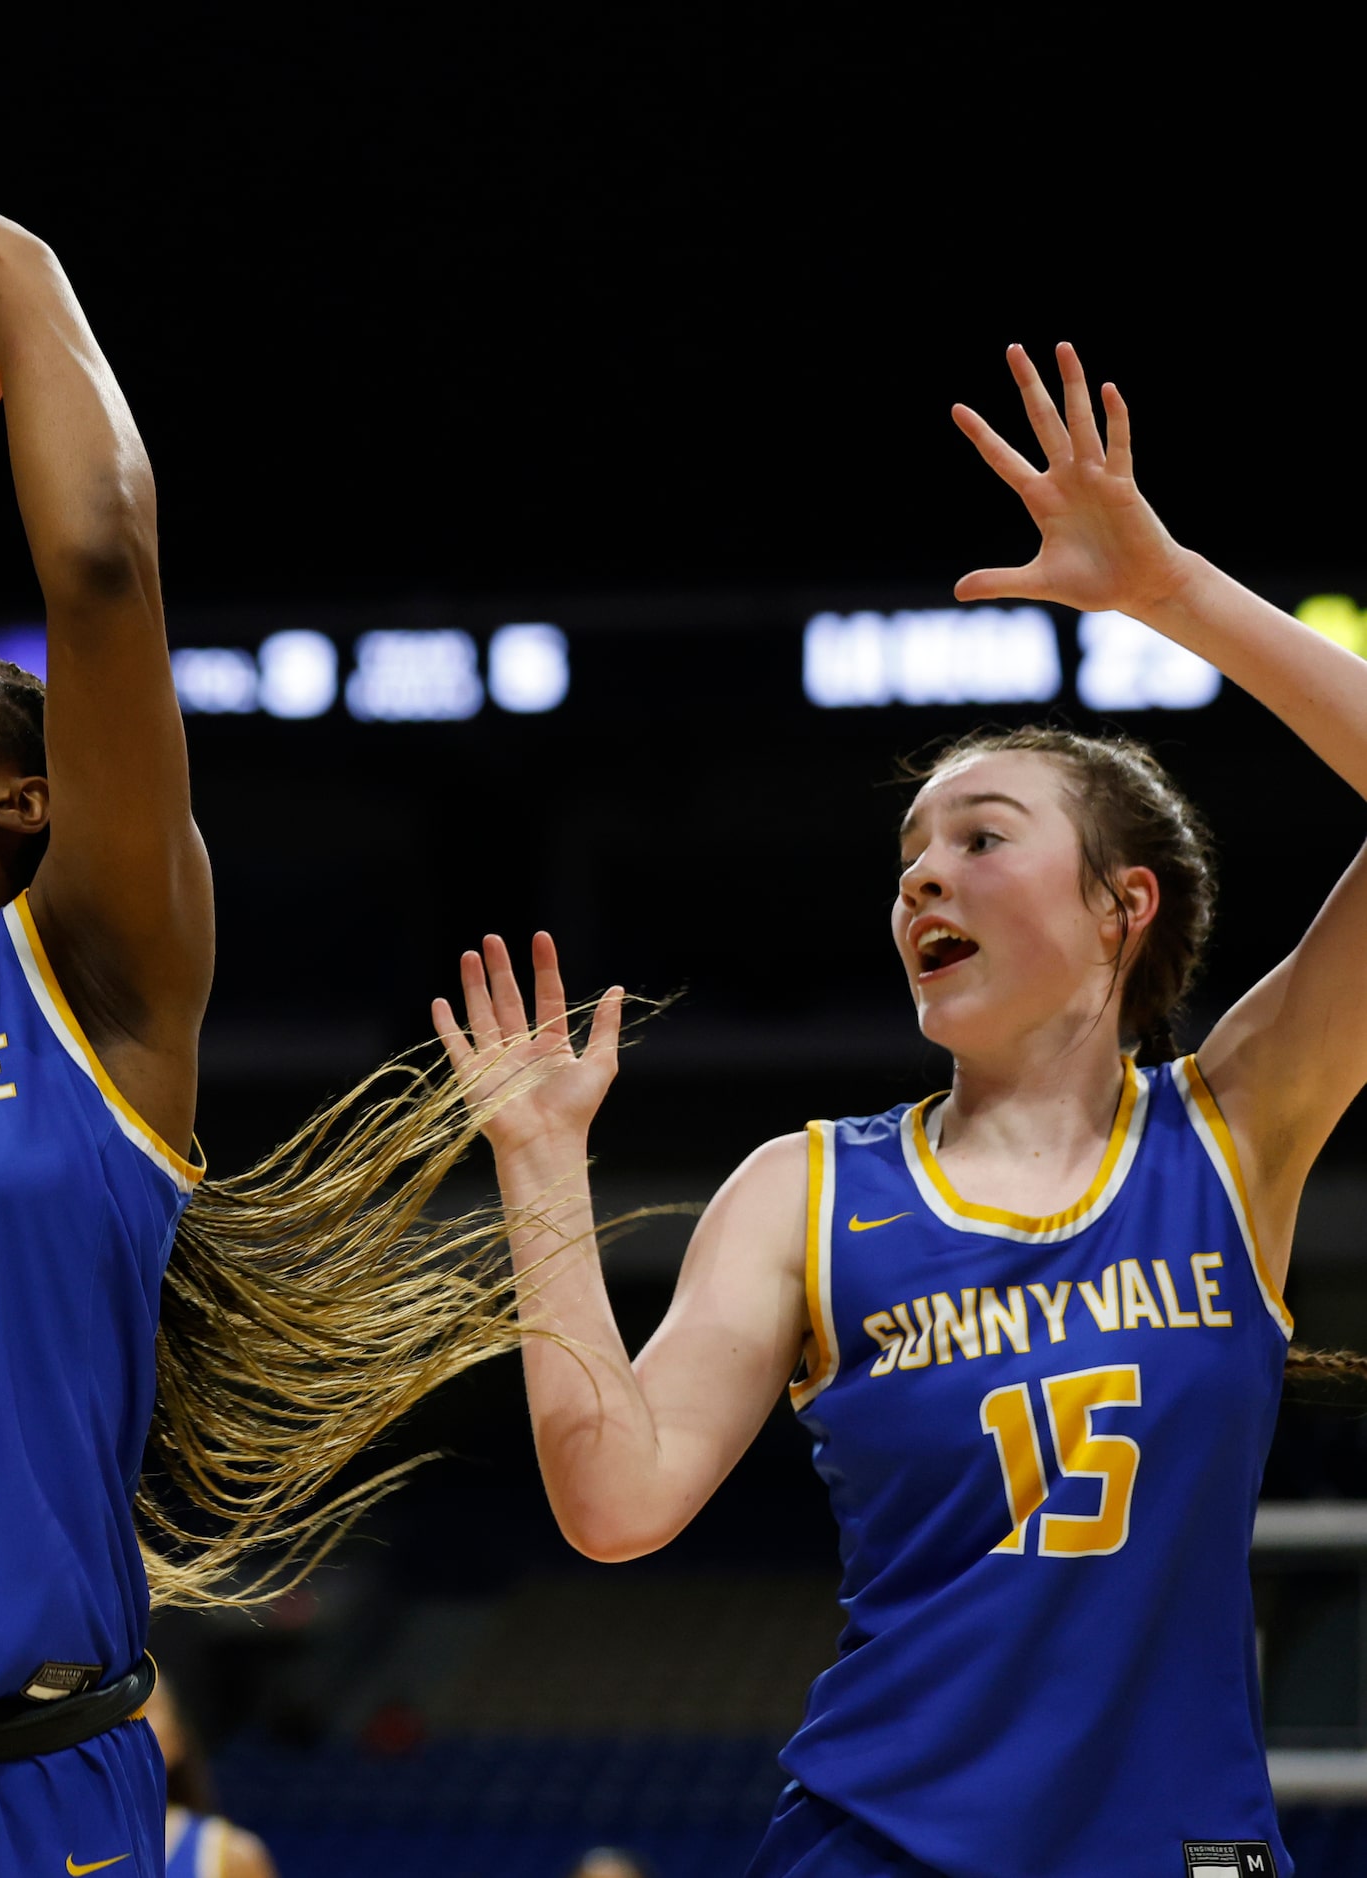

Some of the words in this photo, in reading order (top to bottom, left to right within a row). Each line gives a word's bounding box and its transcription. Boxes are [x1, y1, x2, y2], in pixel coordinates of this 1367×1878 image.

[862, 1252, 1233, 1377] SUNNYVALE
[979, 1364, 1142, 1558] 15
[1246, 1854, 1265, 1872] M
